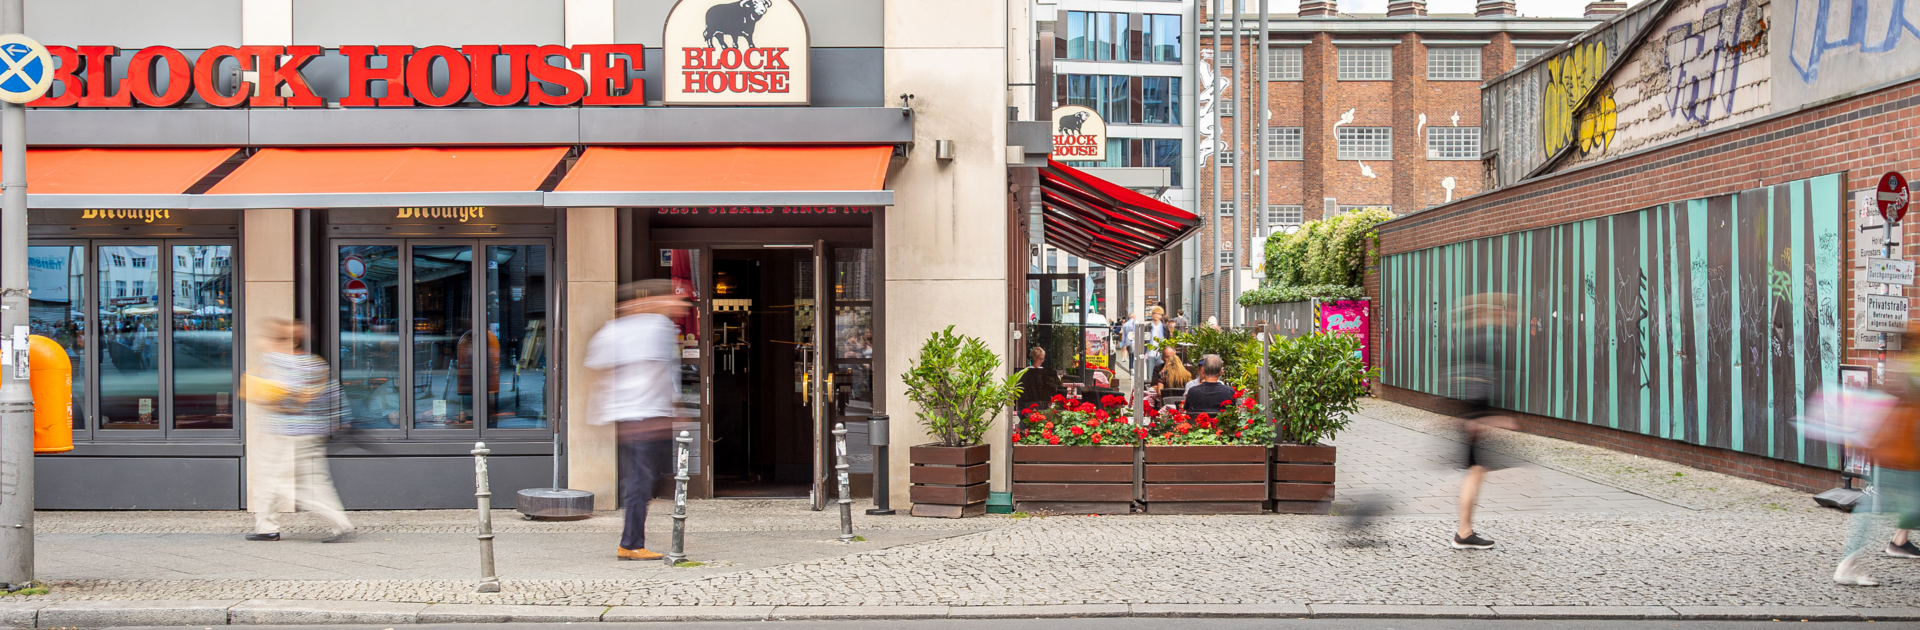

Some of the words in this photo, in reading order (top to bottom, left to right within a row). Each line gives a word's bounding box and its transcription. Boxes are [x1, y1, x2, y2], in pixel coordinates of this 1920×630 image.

[682, 47, 789, 70] BLOCK
[25, 45, 325, 107] BLOCK
[339, 44, 645, 106] HOUSE
[682, 71, 789, 93] HOUSE
[1868, 298, 1907, 312] Privatstraße
[1326, 313, 1363, 330] Pink
[1872, 311, 1894, 319] Betreten
[1871, 320, 1888, 328] eigene
[1888, 320, 1904, 329] Gefahr
